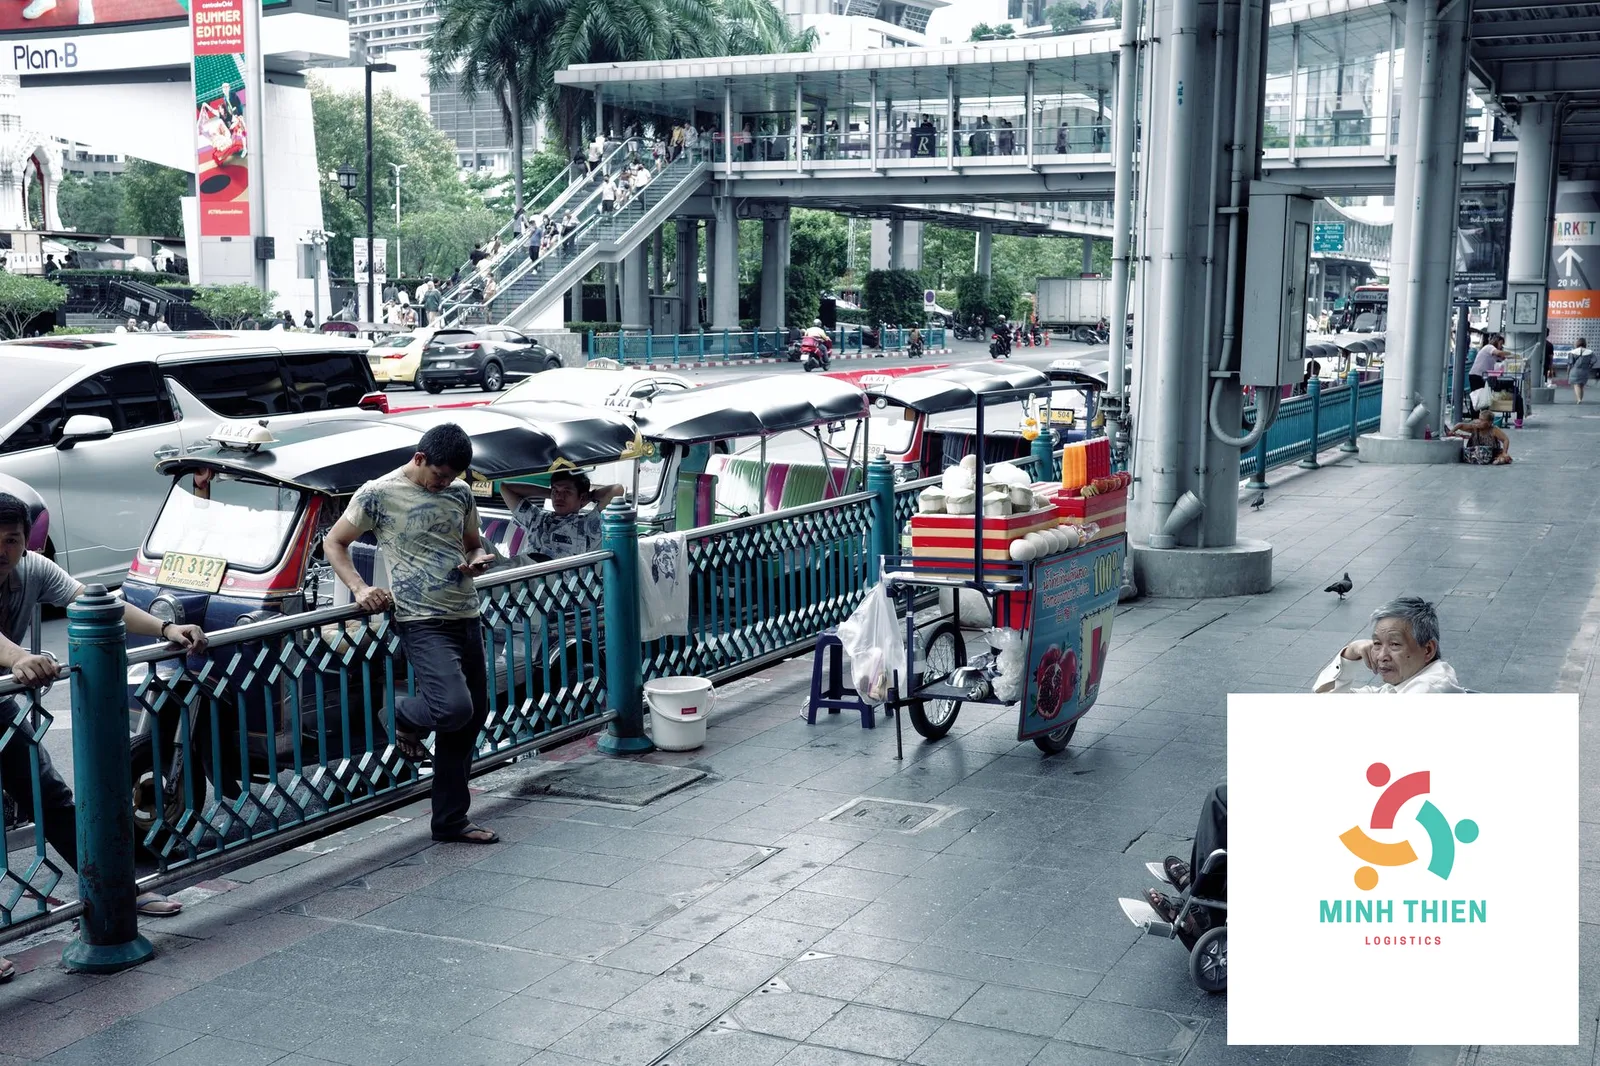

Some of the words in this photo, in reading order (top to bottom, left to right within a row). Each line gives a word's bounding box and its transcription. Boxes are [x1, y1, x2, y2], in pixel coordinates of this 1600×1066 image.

[196, 24, 241, 38] EDITION
[918, 136, 929, 151] R
[1558, 279, 1567, 287] 20
[604, 398, 631, 408] TAXI
[219, 424, 255, 439] TAXI
[187, 557, 225, 577] 3127
